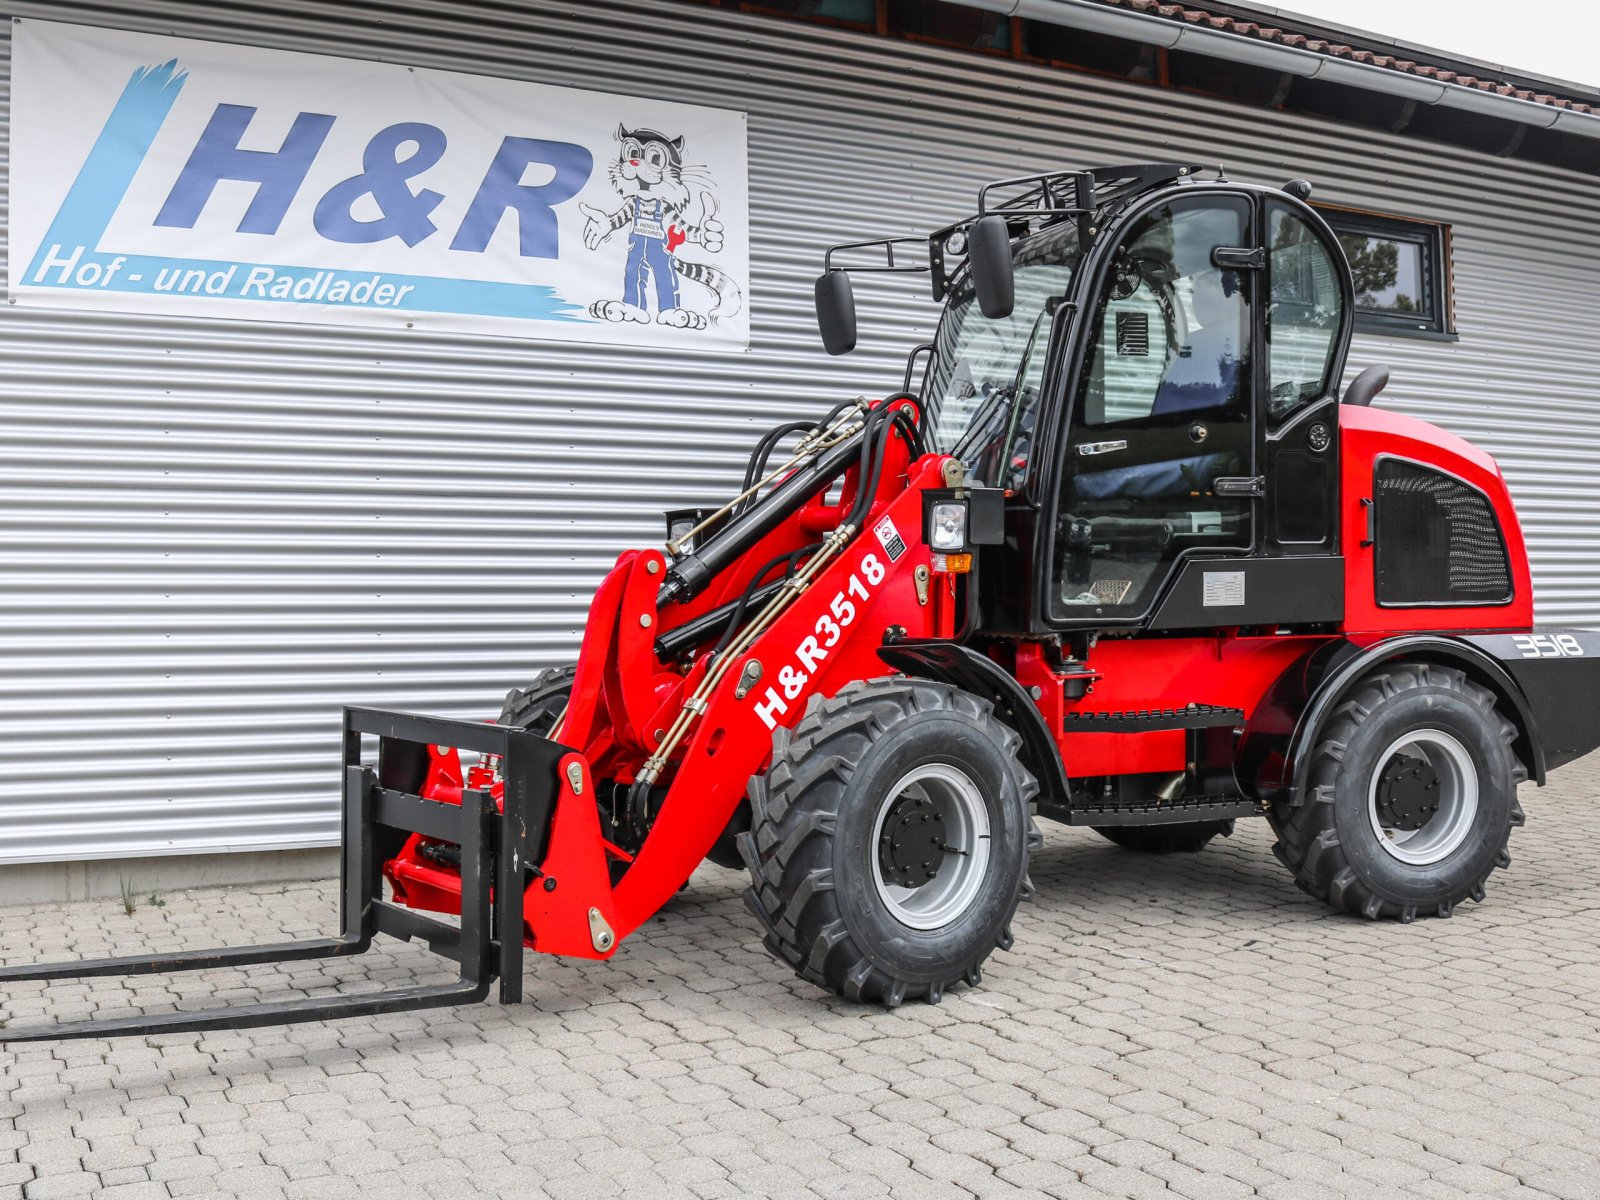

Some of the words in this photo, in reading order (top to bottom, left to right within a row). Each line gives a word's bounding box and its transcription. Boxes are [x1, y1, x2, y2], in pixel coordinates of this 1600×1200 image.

[153, 103, 593, 259] H&R
[32, 243, 127, 289] Hof
[153, 265, 238, 296] und
[240, 266, 415, 307] Radlader
[753, 553, 886, 731] H&R3518
[1512, 634, 1584, 658] 3518
